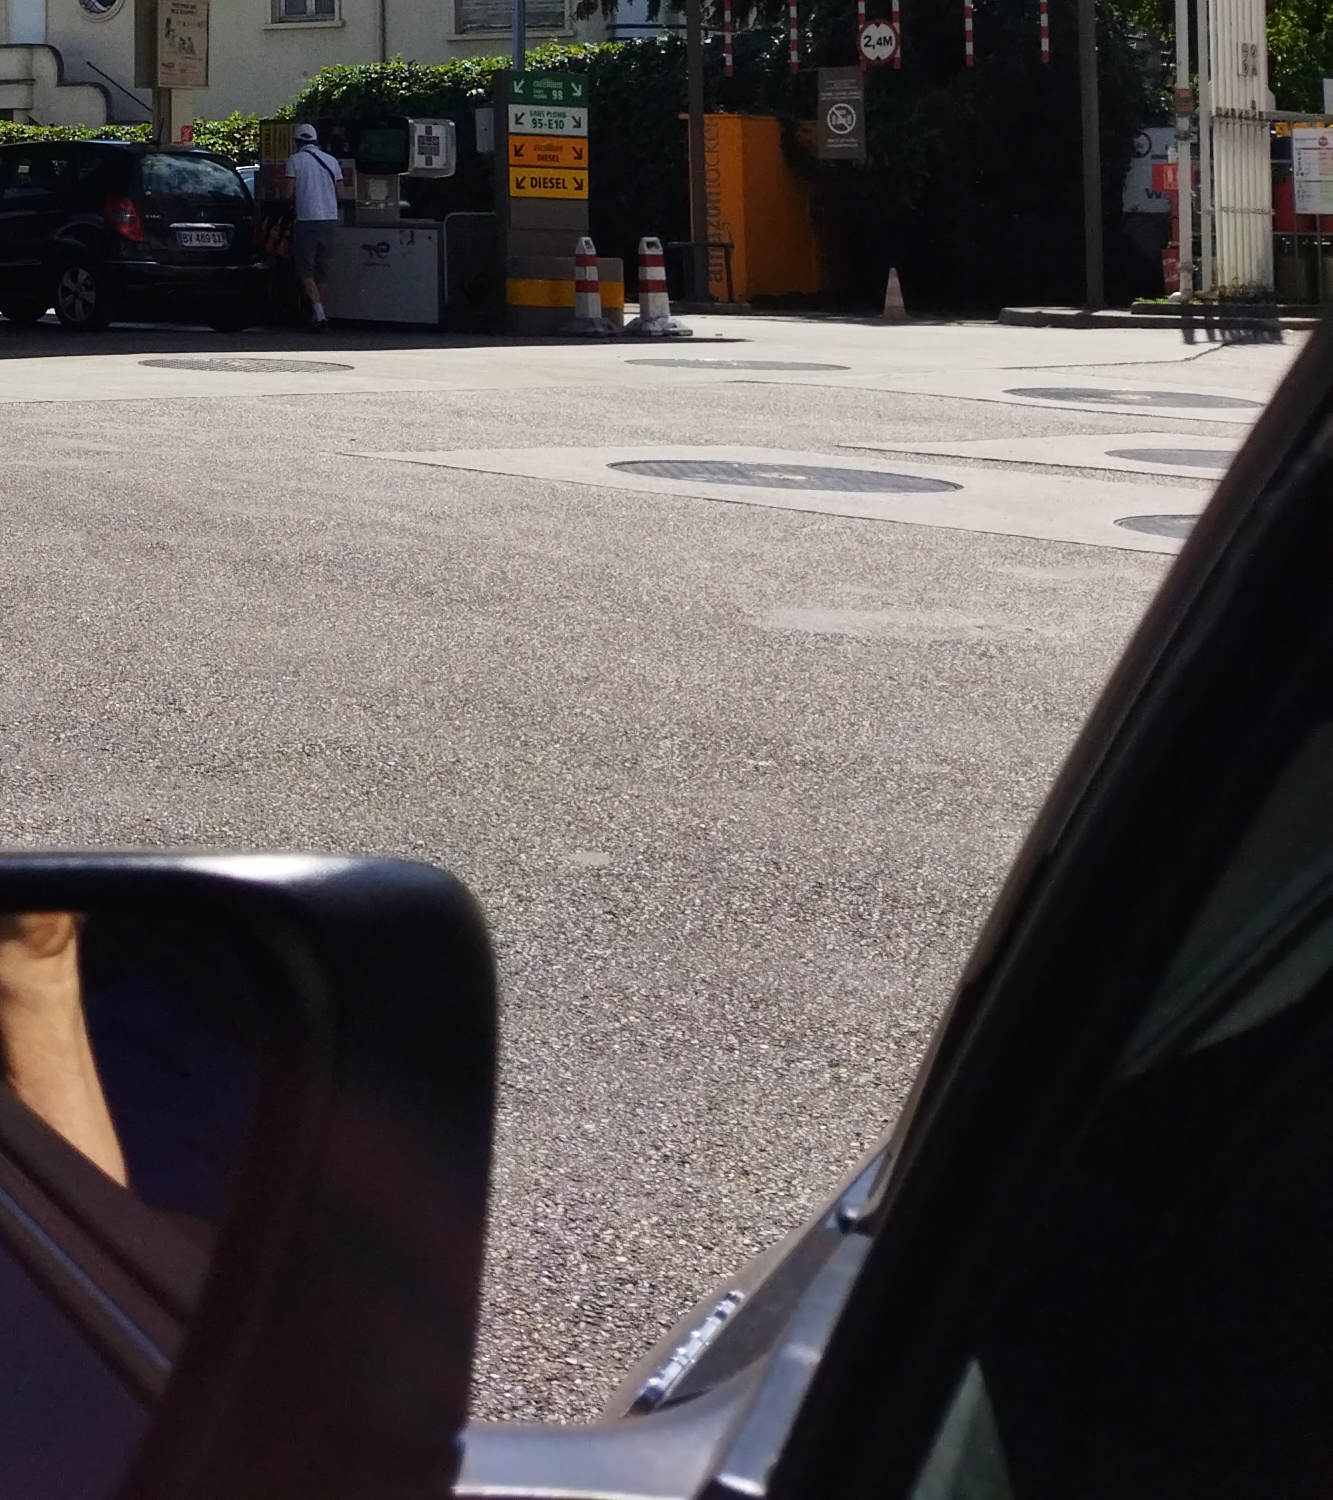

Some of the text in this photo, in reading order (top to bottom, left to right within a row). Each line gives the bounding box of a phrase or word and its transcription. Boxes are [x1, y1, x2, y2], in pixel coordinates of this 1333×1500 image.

[863, 34, 893, 51] 2,4M
[531, 119, 565, 130] 95-E10
[530, 176, 568, 190] DIESEL
